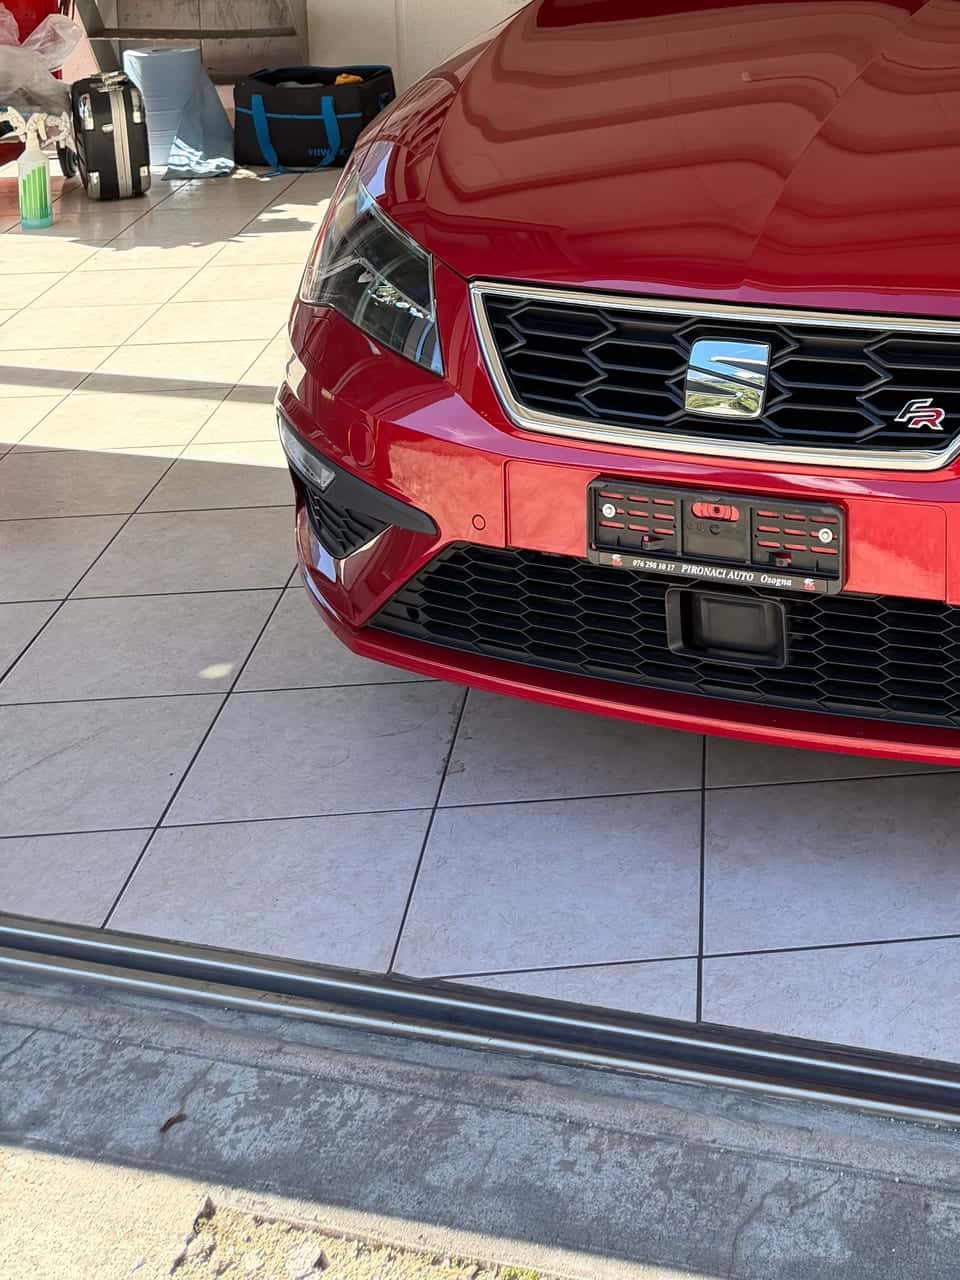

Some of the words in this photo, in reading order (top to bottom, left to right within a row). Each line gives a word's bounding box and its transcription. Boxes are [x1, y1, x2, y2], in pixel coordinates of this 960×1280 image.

[894, 397, 946, 430] FR
[681, 564, 726, 578] PIRONACI
[727, 570, 754, 582] AUTO
[760, 574, 792, 587] Osogna
